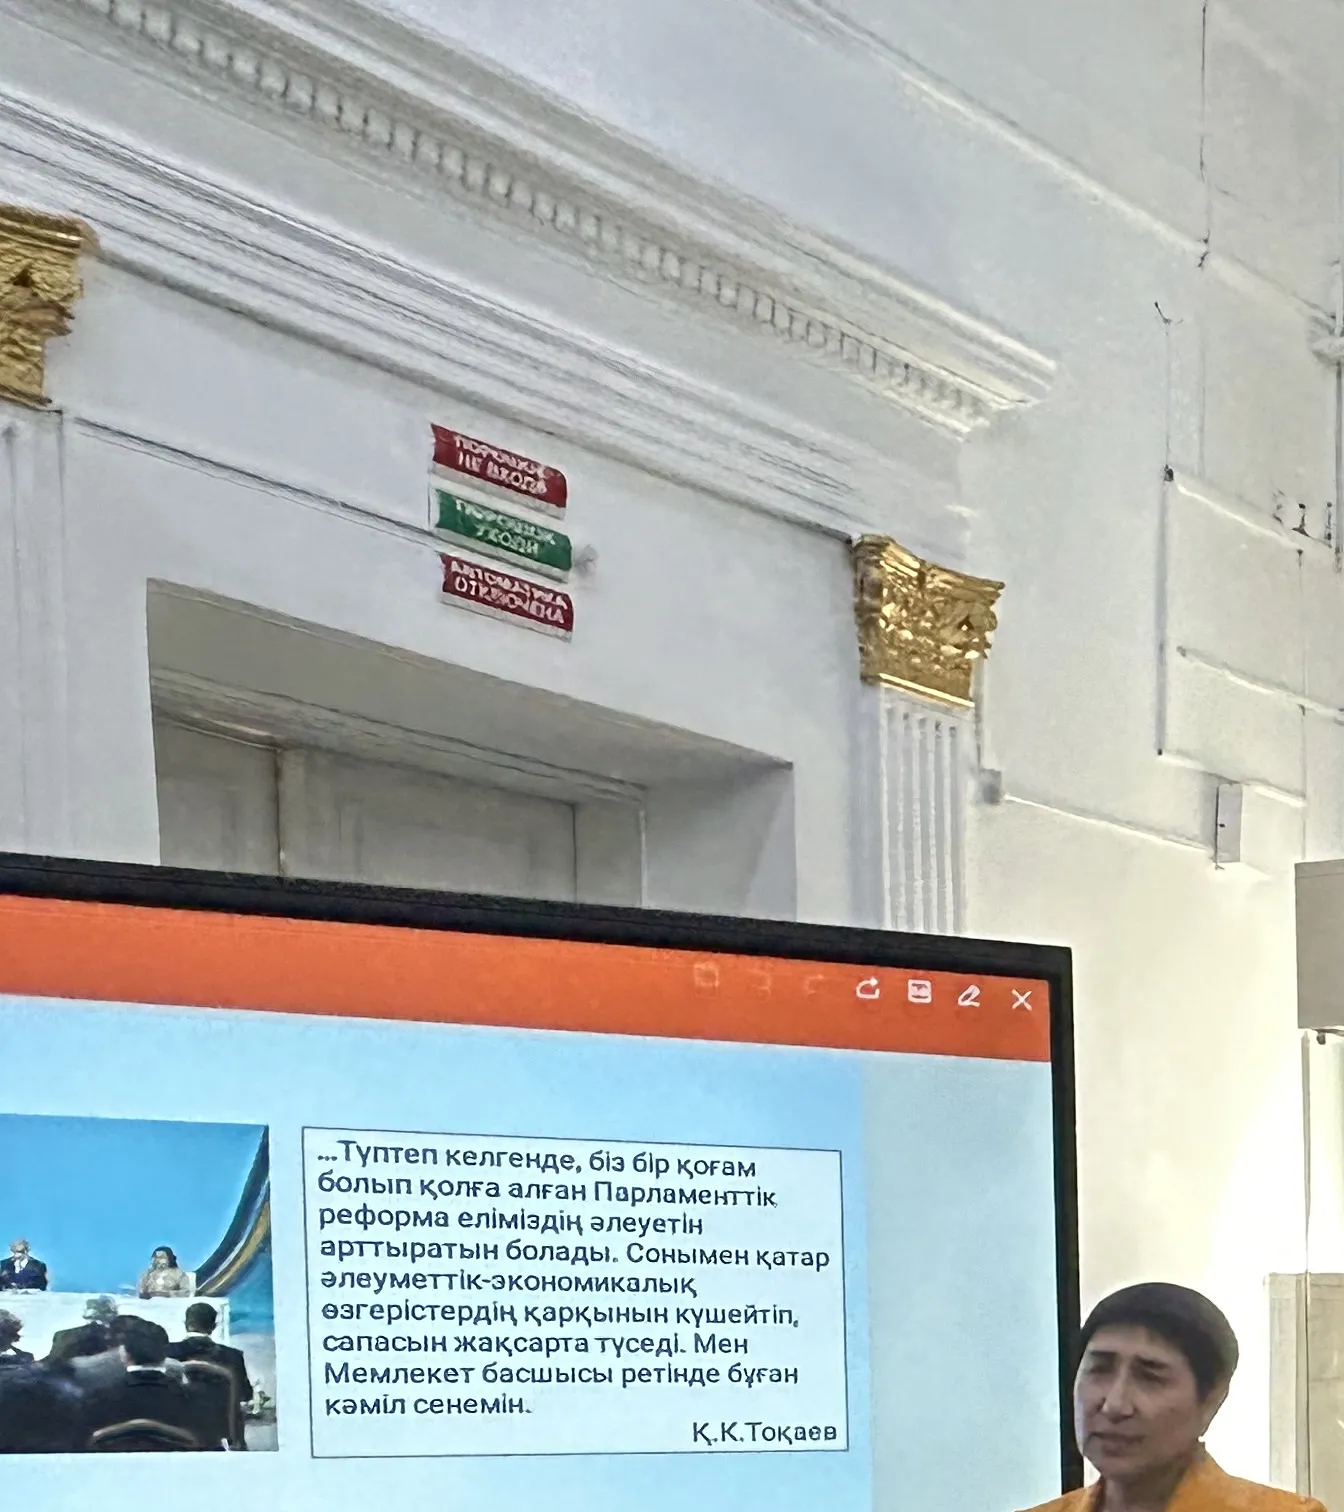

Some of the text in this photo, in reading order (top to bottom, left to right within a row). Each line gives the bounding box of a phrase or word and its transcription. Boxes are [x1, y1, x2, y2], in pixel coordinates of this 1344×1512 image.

[444, 1148, 583, 1175] келгенде,
[588, 1149, 626, 1173] біз
[632, 1150, 671, 1180] бір
[676, 1158, 756, 1180] қоғам
[317, 1168, 779, 1209] болып қолға алған Парламенттік
[318, 1201, 704, 1239] реформа еліміздің әлеуетін
[319, 1237, 831, 1273] арттыратын болады. Сонымен қатар
[320, 1268, 698, 1299] әлеуметтік-экономикалық
[320, 1298, 799, 1329] өзгерістердің қарқынын күшейтіп,
[322, 1331, 749, 1359] сапасын жақсарта түседі. Мен
[324, 1360, 799, 1390] Мемлекет басшысы ретінде бұған
[324, 1392, 533, 1417] кәміл сенемін.
